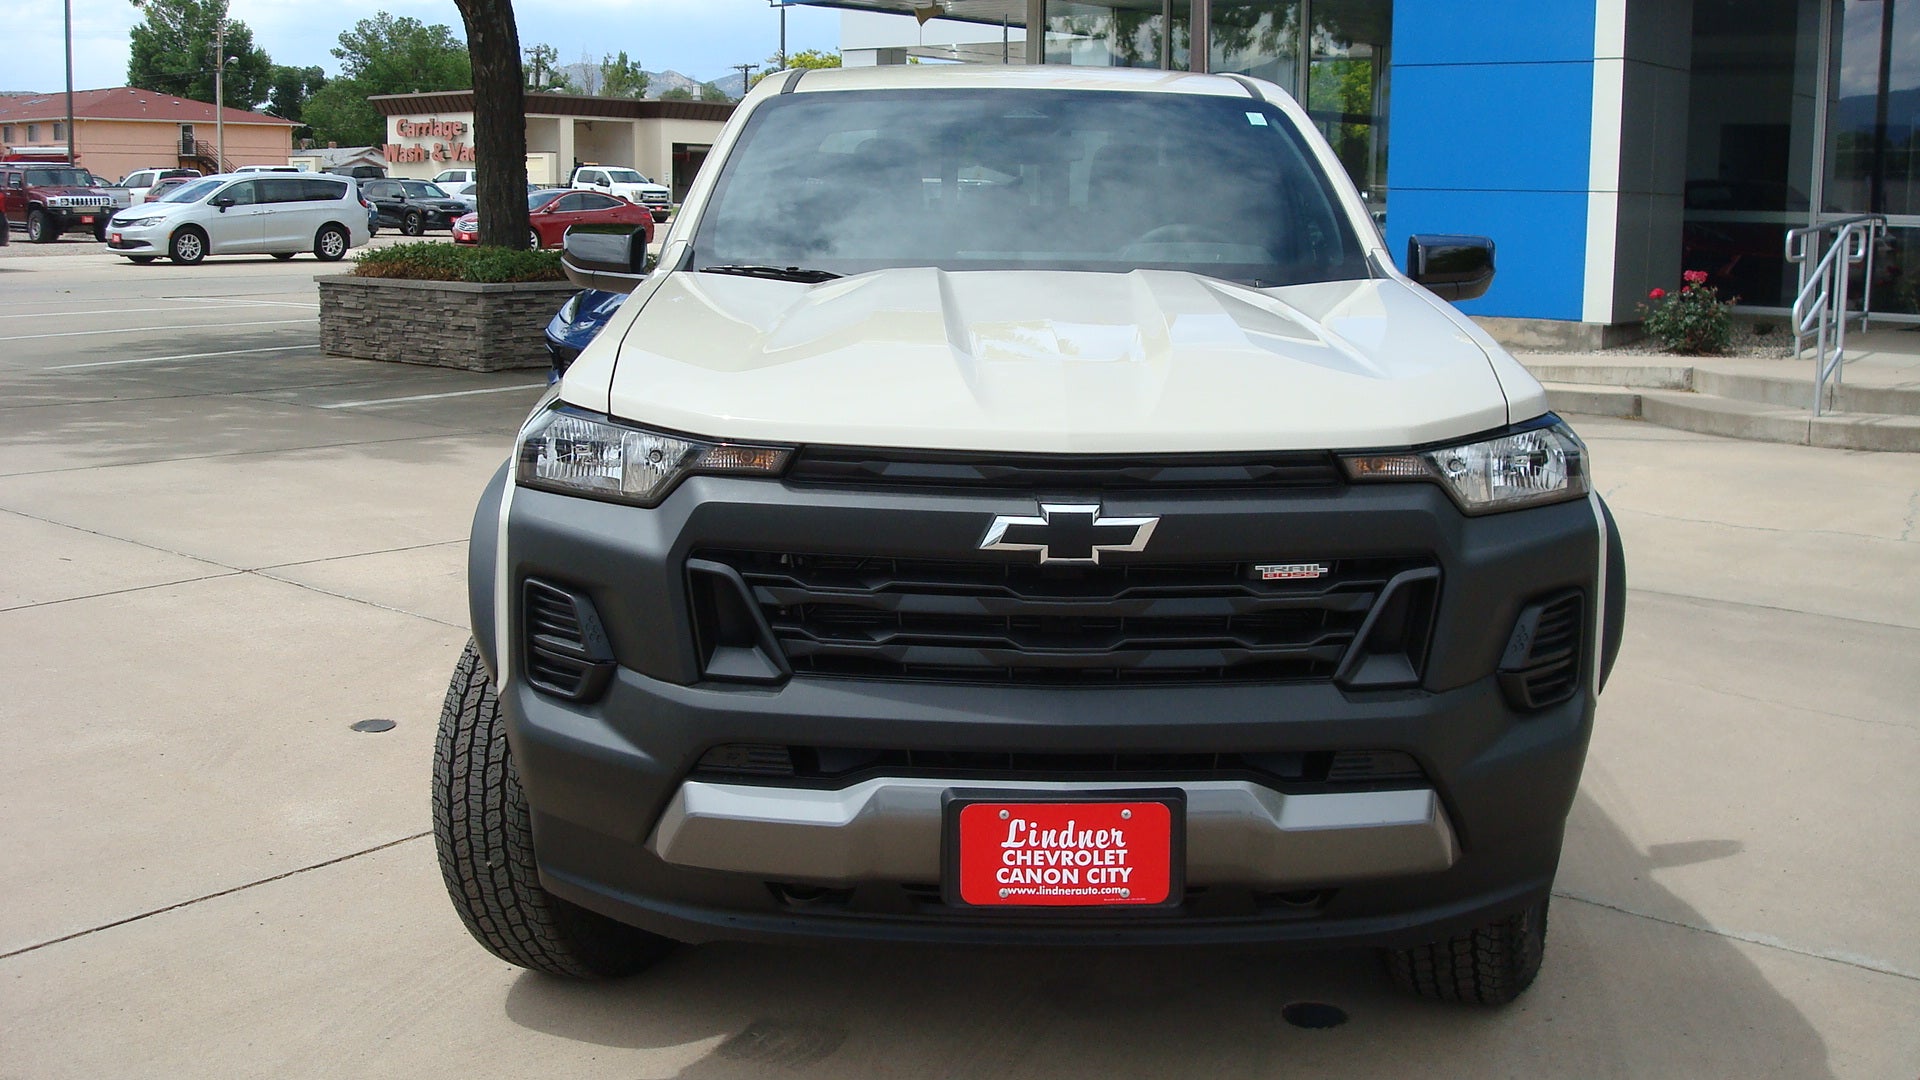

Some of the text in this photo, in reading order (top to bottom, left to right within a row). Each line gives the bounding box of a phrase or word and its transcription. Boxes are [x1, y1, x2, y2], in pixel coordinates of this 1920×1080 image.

[396, 118, 464, 141] Carriage
[382, 143, 427, 162] Wash
[431, 142, 446, 162] &
[1255, 564, 1328, 573] TRAIL
[1001, 819, 1126, 849] Lindner
[1002, 850, 1128, 866] CHEVROLET
[996, 867, 1133, 884] CANON CITY
[1008, 886, 1121, 896] www.lindnerauto.com
